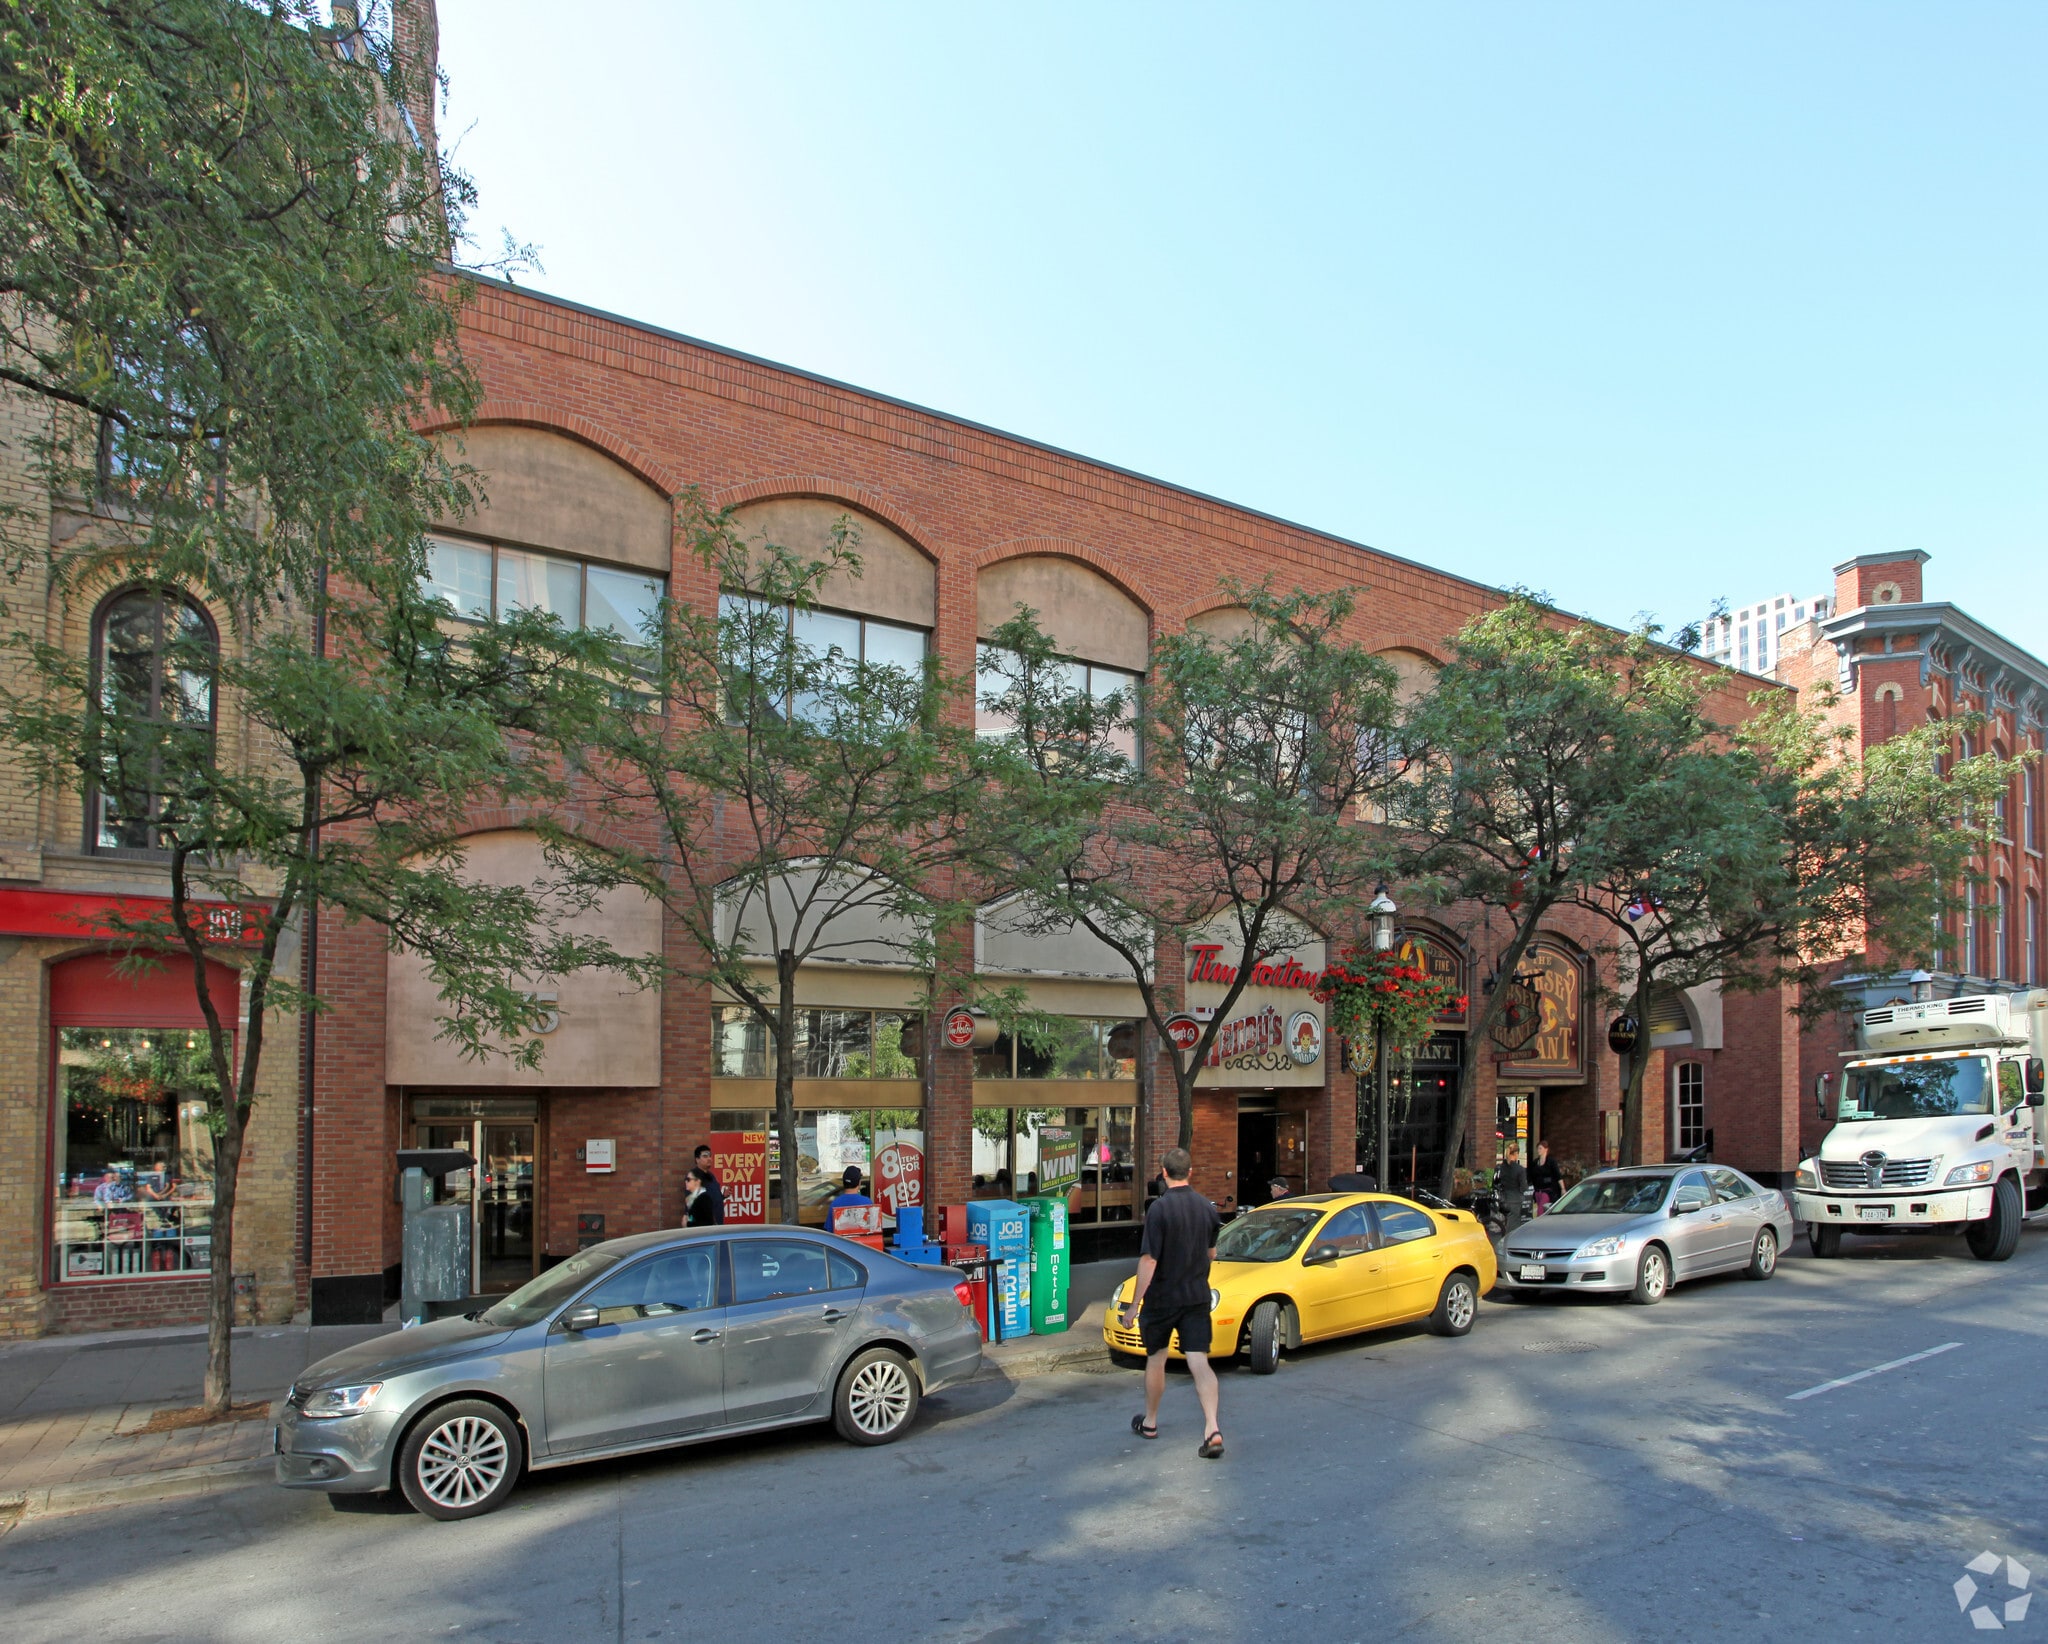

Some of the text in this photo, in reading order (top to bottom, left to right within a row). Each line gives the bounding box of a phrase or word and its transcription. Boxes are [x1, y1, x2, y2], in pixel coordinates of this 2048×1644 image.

[1190, 944, 1237, 983] Tim
[1434, 959, 1450, 972] FINE
[1897, 1004, 1925, 1013] THERMO
[1401, 1042, 1453, 1060] GIANT
[744, 1134, 766, 1142] NEW
[714, 1153, 765, 1168] EVERY
[881, 1150, 900, 1179] 8
[900, 1162, 920, 1172] FOR
[1042, 1154, 1077, 1181] WIN
[722, 1168, 755, 1183] DAY
[970, 1223, 988, 1236] JOB
[998, 1221, 1024, 1235] JOB
[1004, 1258, 1018, 1326] FREE
